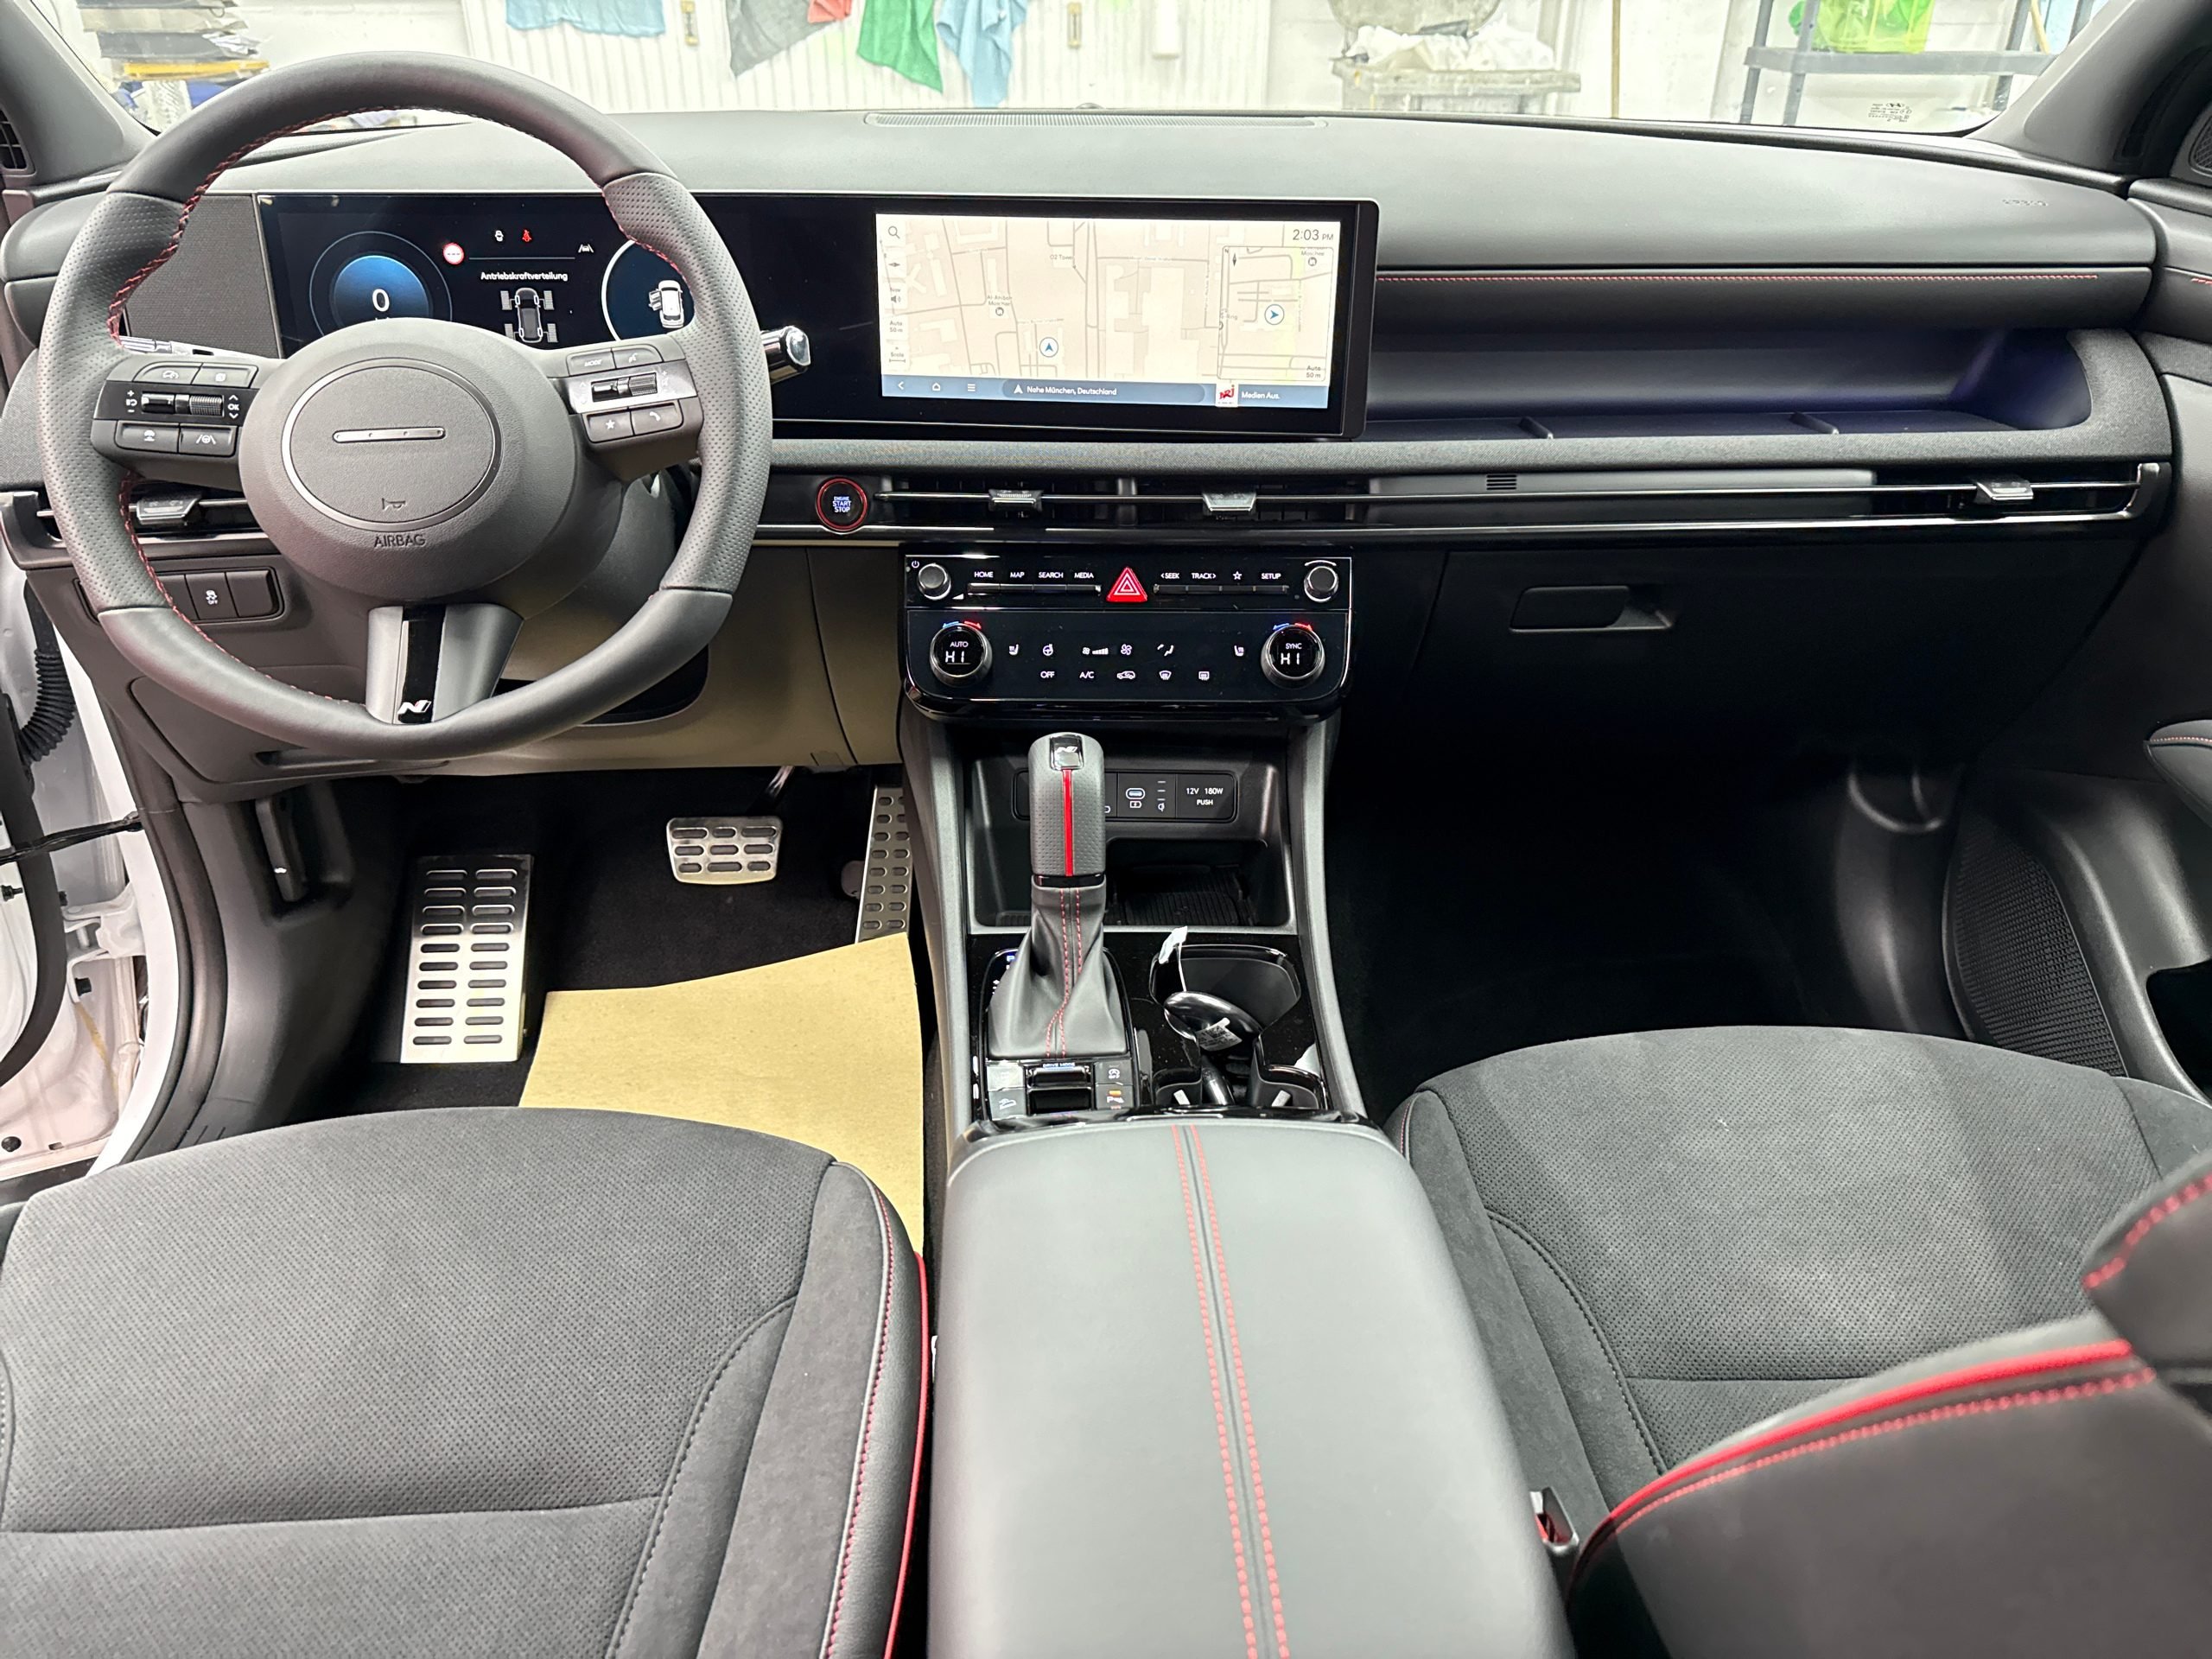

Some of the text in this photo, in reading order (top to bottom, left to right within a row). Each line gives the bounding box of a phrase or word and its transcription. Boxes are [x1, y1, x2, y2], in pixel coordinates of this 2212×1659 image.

[1293, 229, 1319, 240] 2:03
[480, 271, 568, 282] Antriebskraftverteilung
[372, 289, 390, 312] 0
[1046, 386, 1076, 395] München,
[374, 534, 426, 547] AIRBAG
